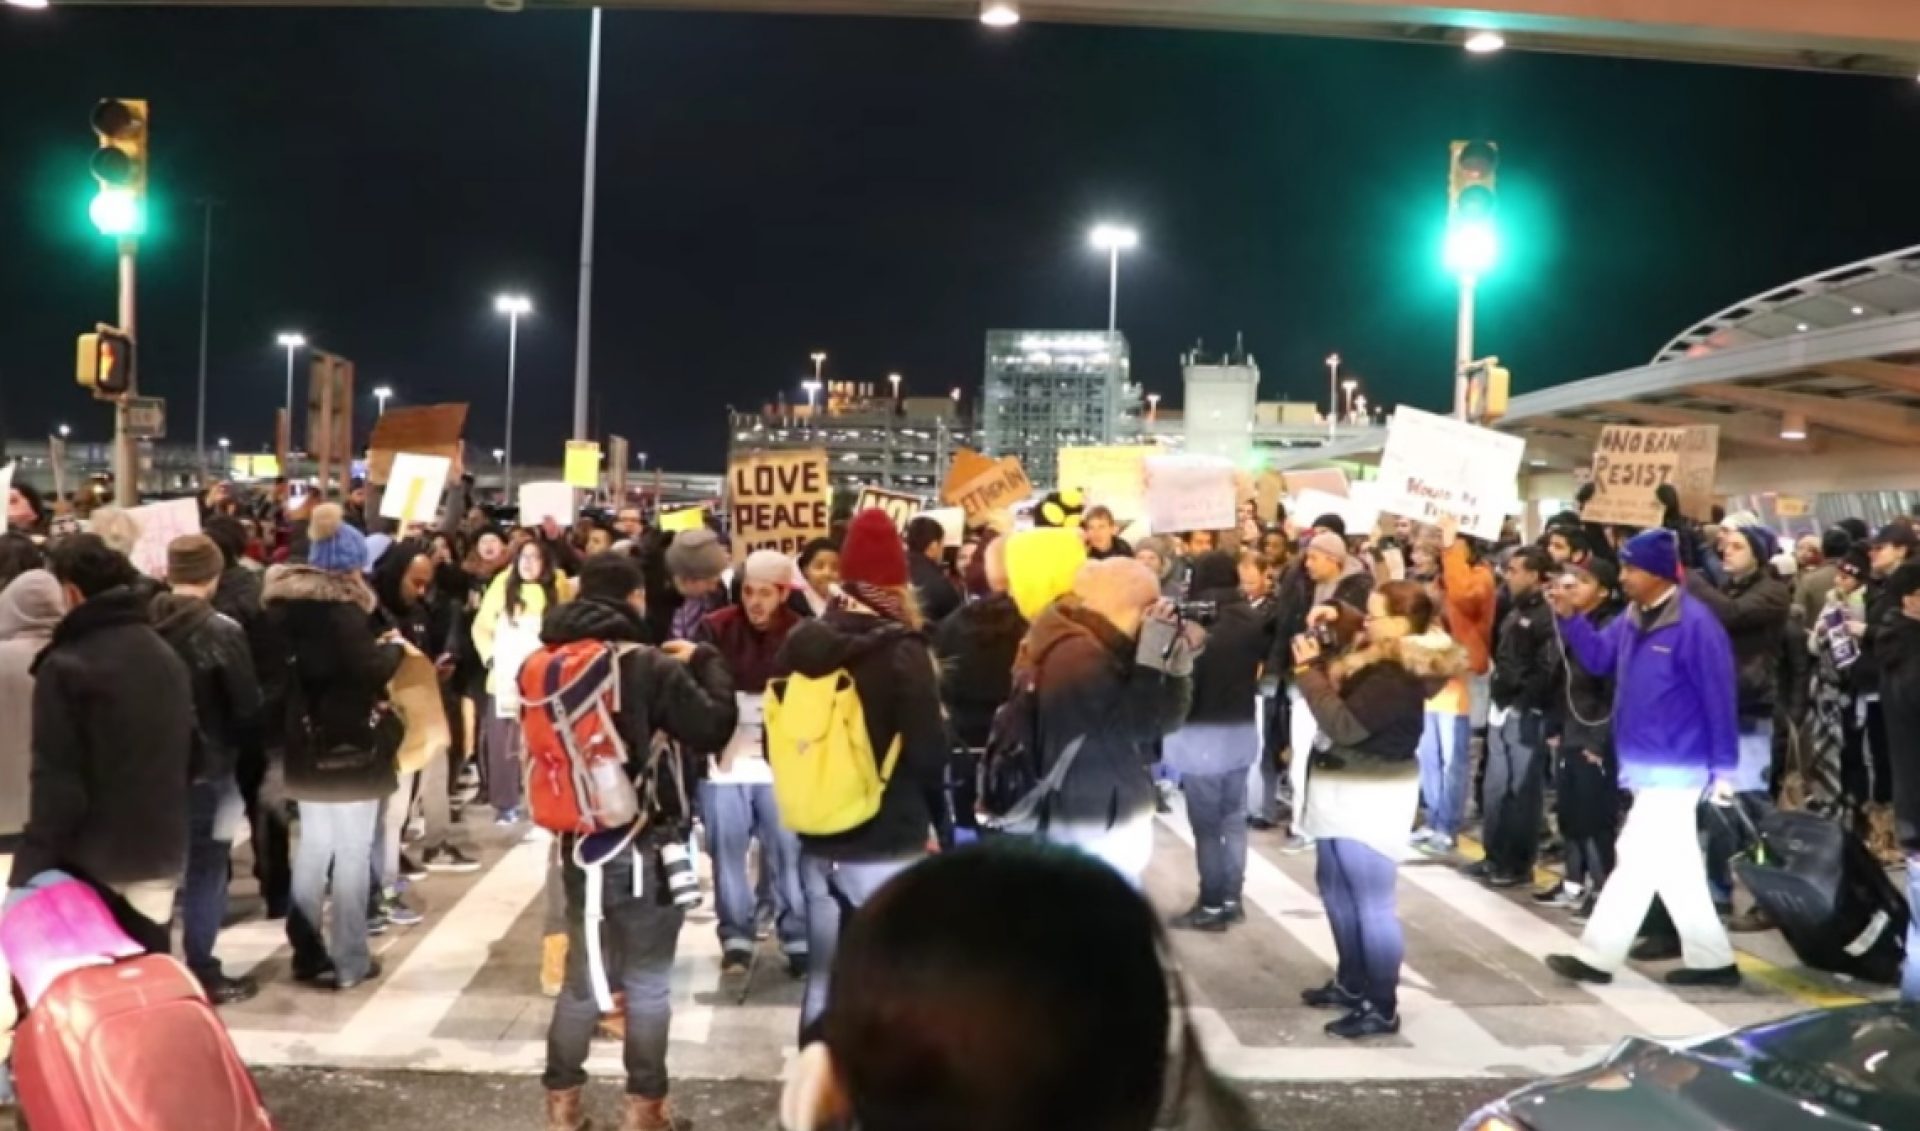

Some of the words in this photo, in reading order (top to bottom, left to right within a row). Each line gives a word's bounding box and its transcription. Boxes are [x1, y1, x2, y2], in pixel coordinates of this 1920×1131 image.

[737, 462, 819, 495] LOVE
[1596, 455, 1673, 494] RESIST
[735, 500, 827, 536] PEACE
